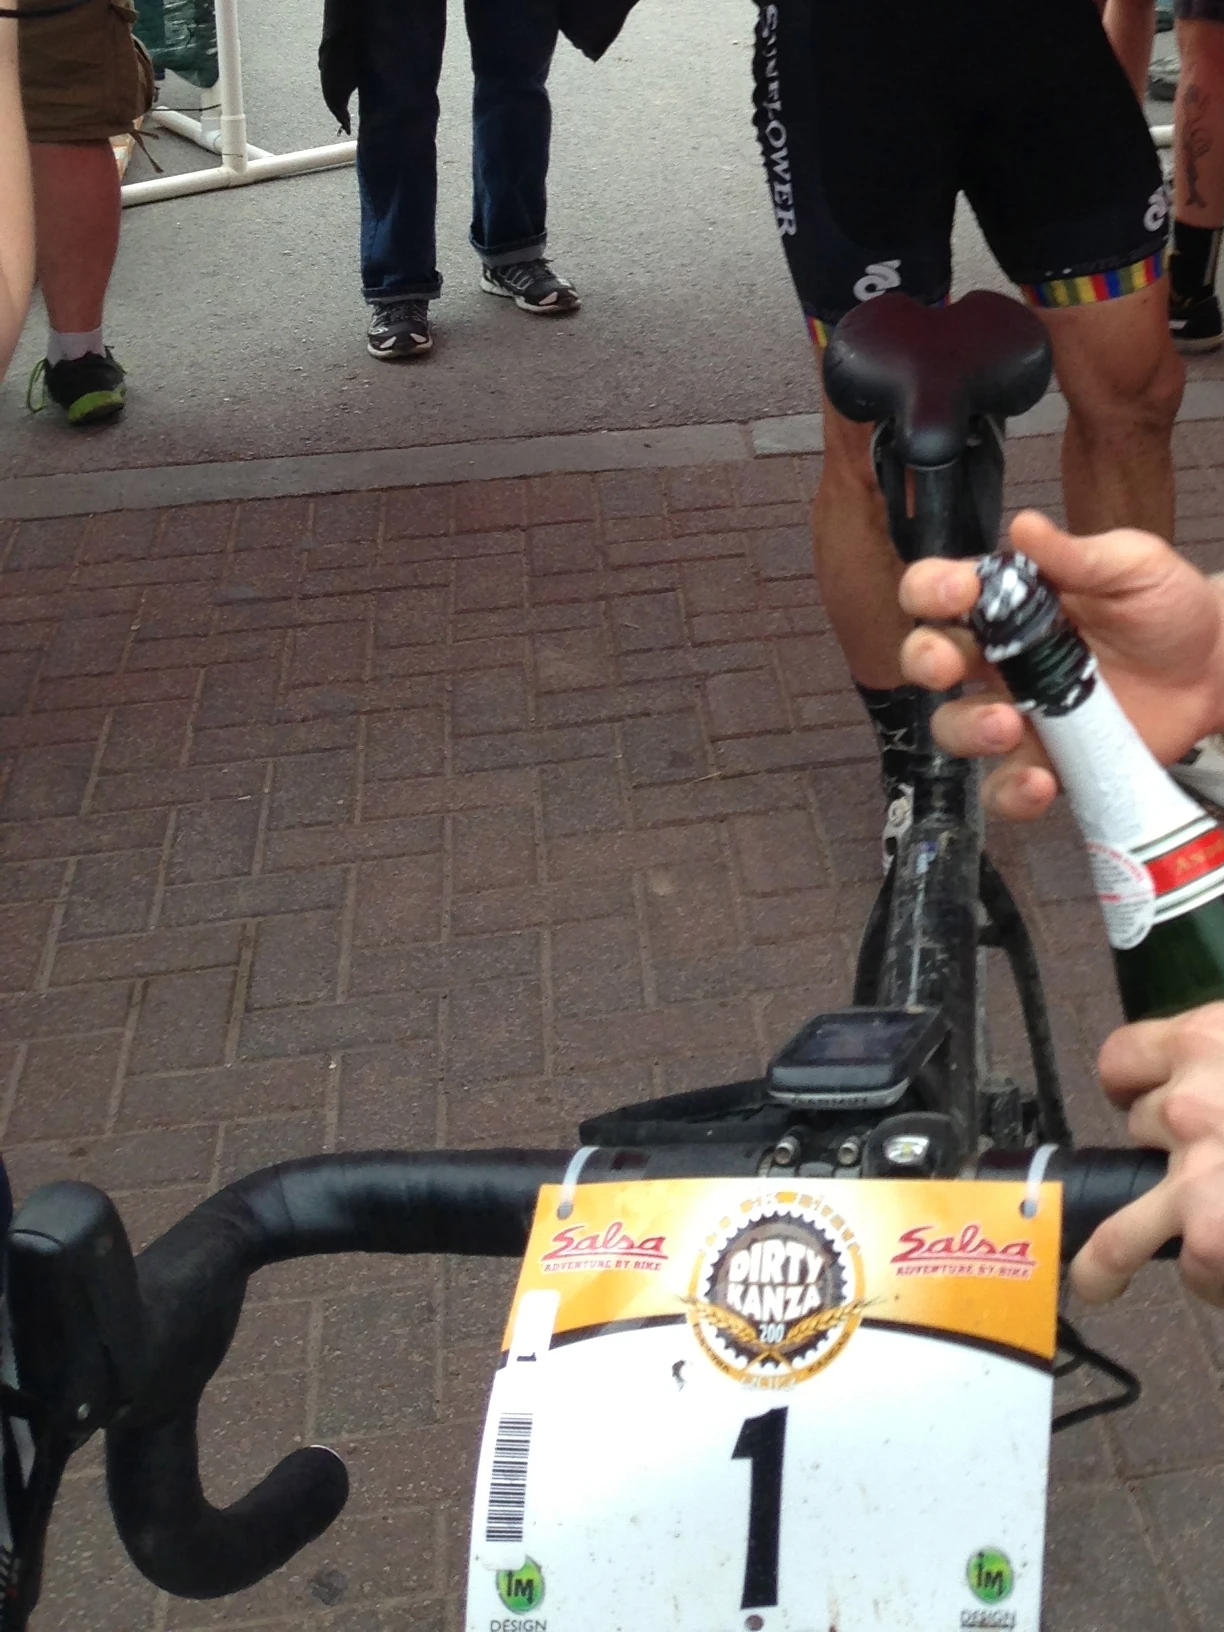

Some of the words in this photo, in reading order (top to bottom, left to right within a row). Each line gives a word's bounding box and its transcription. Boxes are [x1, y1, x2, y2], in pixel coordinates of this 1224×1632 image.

[541, 1221, 669, 1261] Salsa
[890, 1224, 1038, 1266] Salsa
[543, 1260, 612, 1272] ADVENTURE
[614, 1260, 631, 1269] BY
[633, 1261, 662, 1272] BIKE
[727, 1238, 828, 1285] DIRTY
[726, 1282, 823, 1322] KANZA
[759, 1322, 785, 1344] 200
[730, 1406, 789, 1610] 1
[490, 1619, 547, 1632] DESIGN
